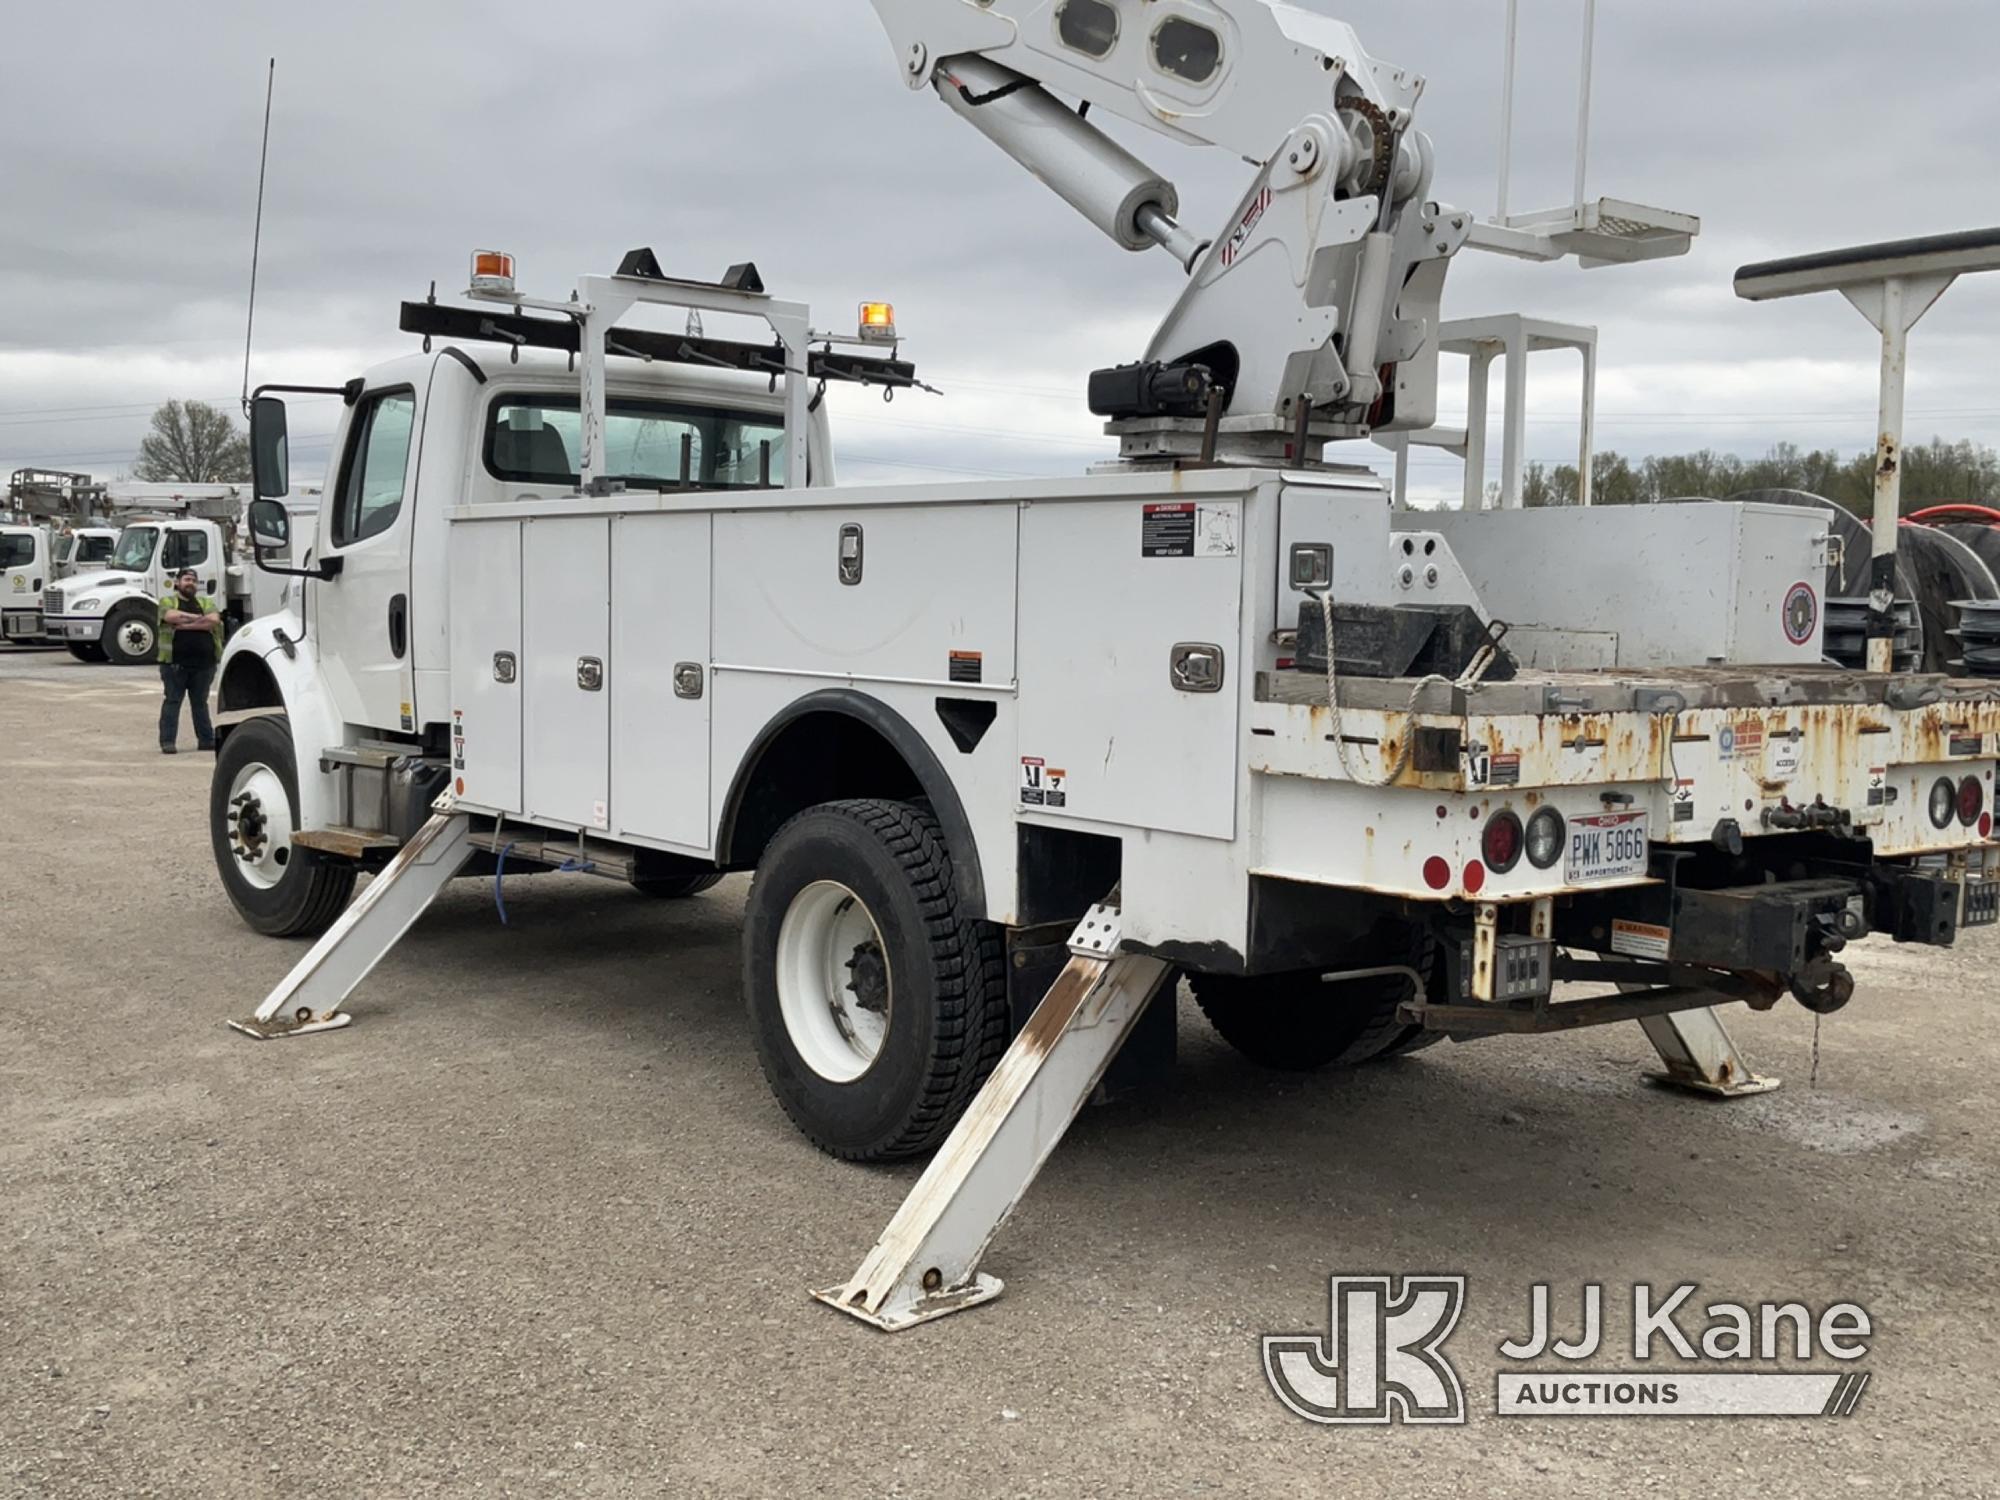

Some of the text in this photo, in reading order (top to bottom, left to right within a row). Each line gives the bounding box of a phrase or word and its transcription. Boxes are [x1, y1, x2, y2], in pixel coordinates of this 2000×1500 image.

[1776, 759, 1795, 767] ACCESS
[1599, 815, 1619, 826] OHIO
[1573, 827, 1643, 868] PWK 5866
